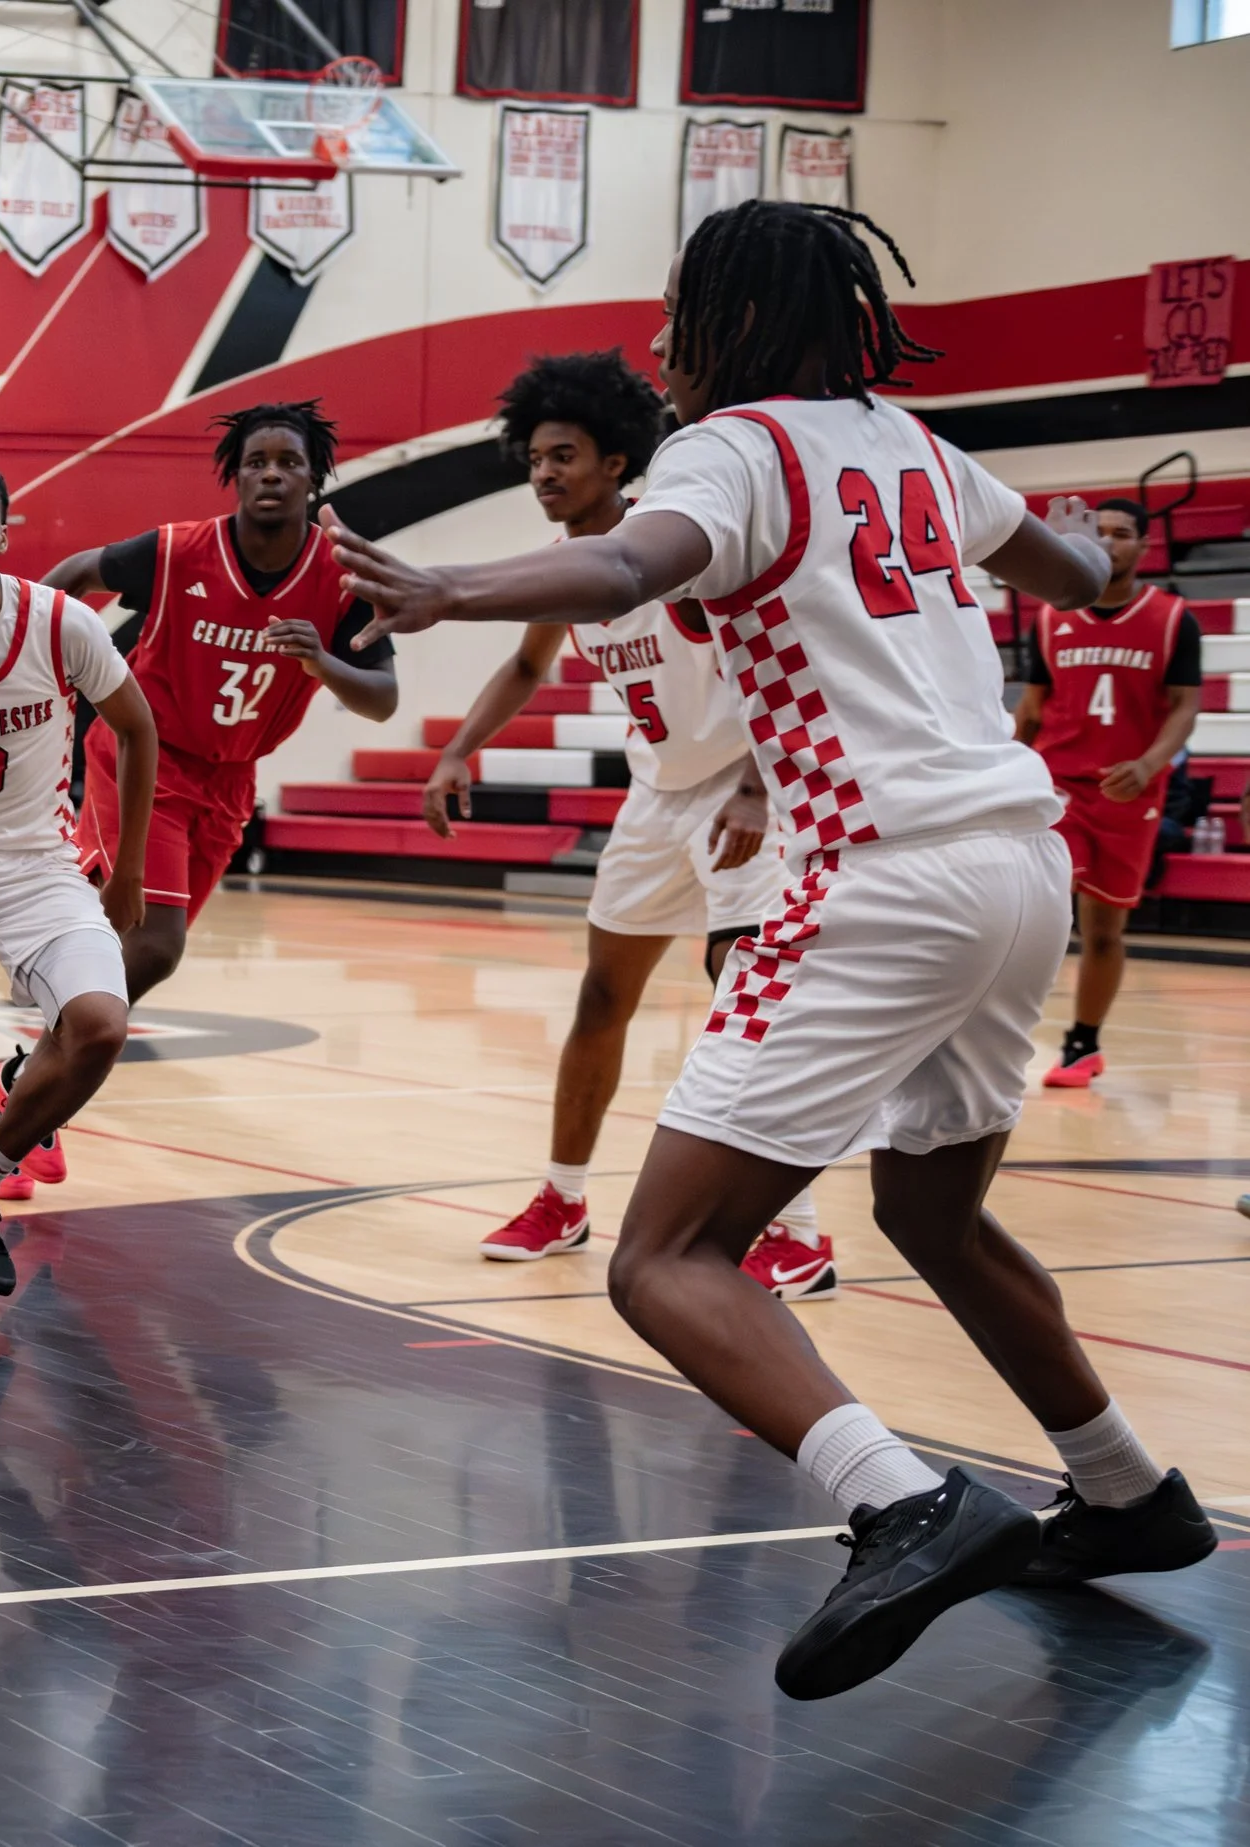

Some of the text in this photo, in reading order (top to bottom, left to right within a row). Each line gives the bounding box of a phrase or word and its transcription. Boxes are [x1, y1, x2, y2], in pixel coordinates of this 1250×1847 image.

[837, 467, 979, 619] 24
[213, 660, 276, 726] 32
[1087, 673, 1116, 726] 4
